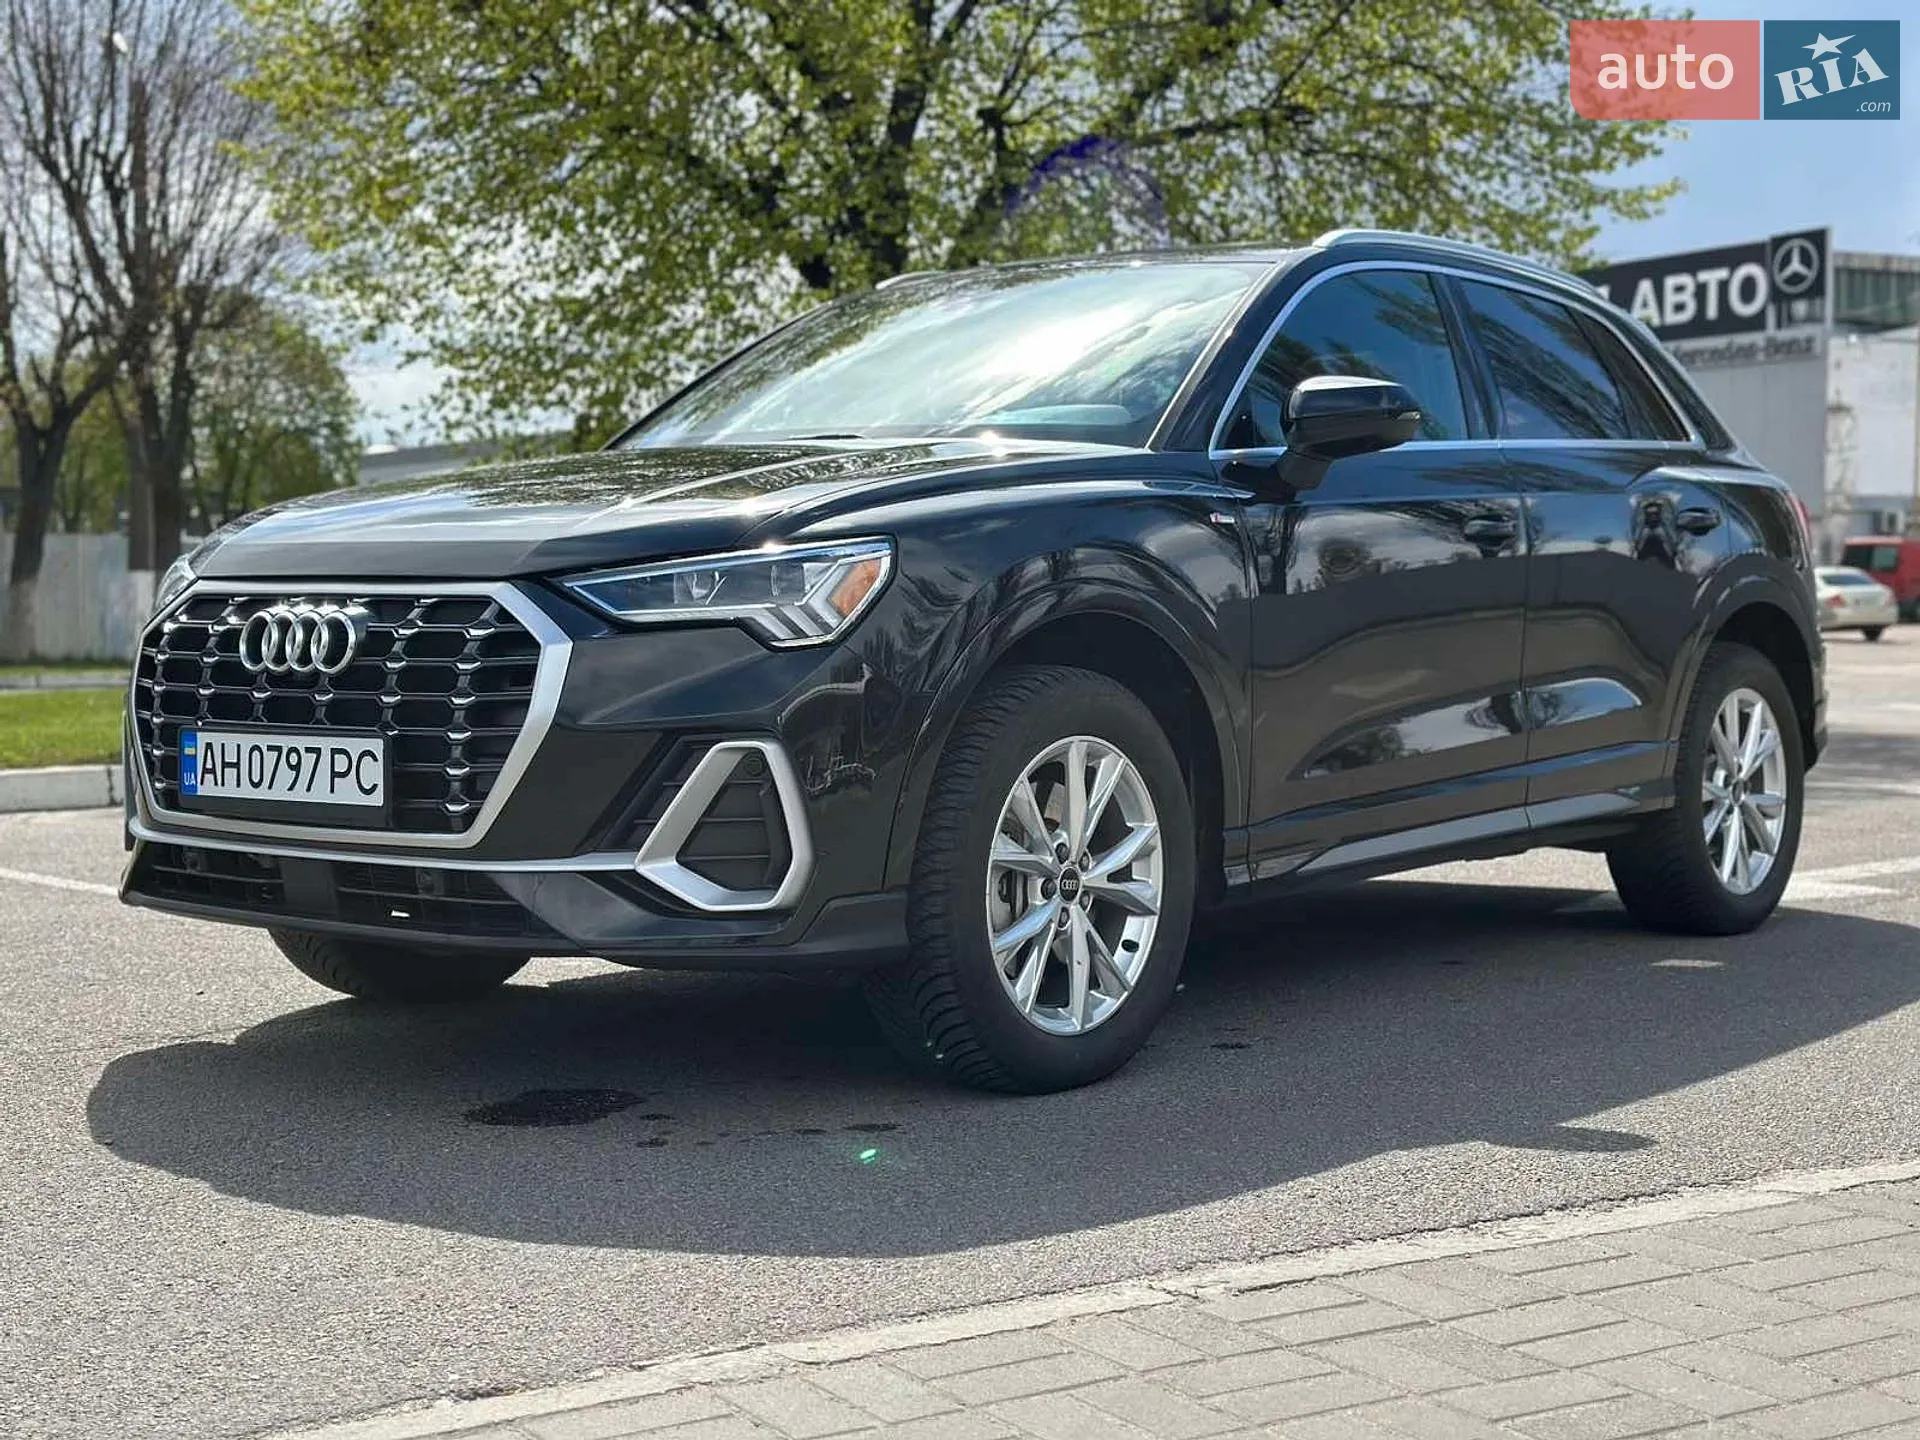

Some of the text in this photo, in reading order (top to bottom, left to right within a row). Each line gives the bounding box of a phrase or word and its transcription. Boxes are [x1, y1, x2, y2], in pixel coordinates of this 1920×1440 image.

[1629, 261, 1769, 327] АВТО
[183, 774, 196, 786] UA
[200, 742, 379, 796] AH 0797 PC
